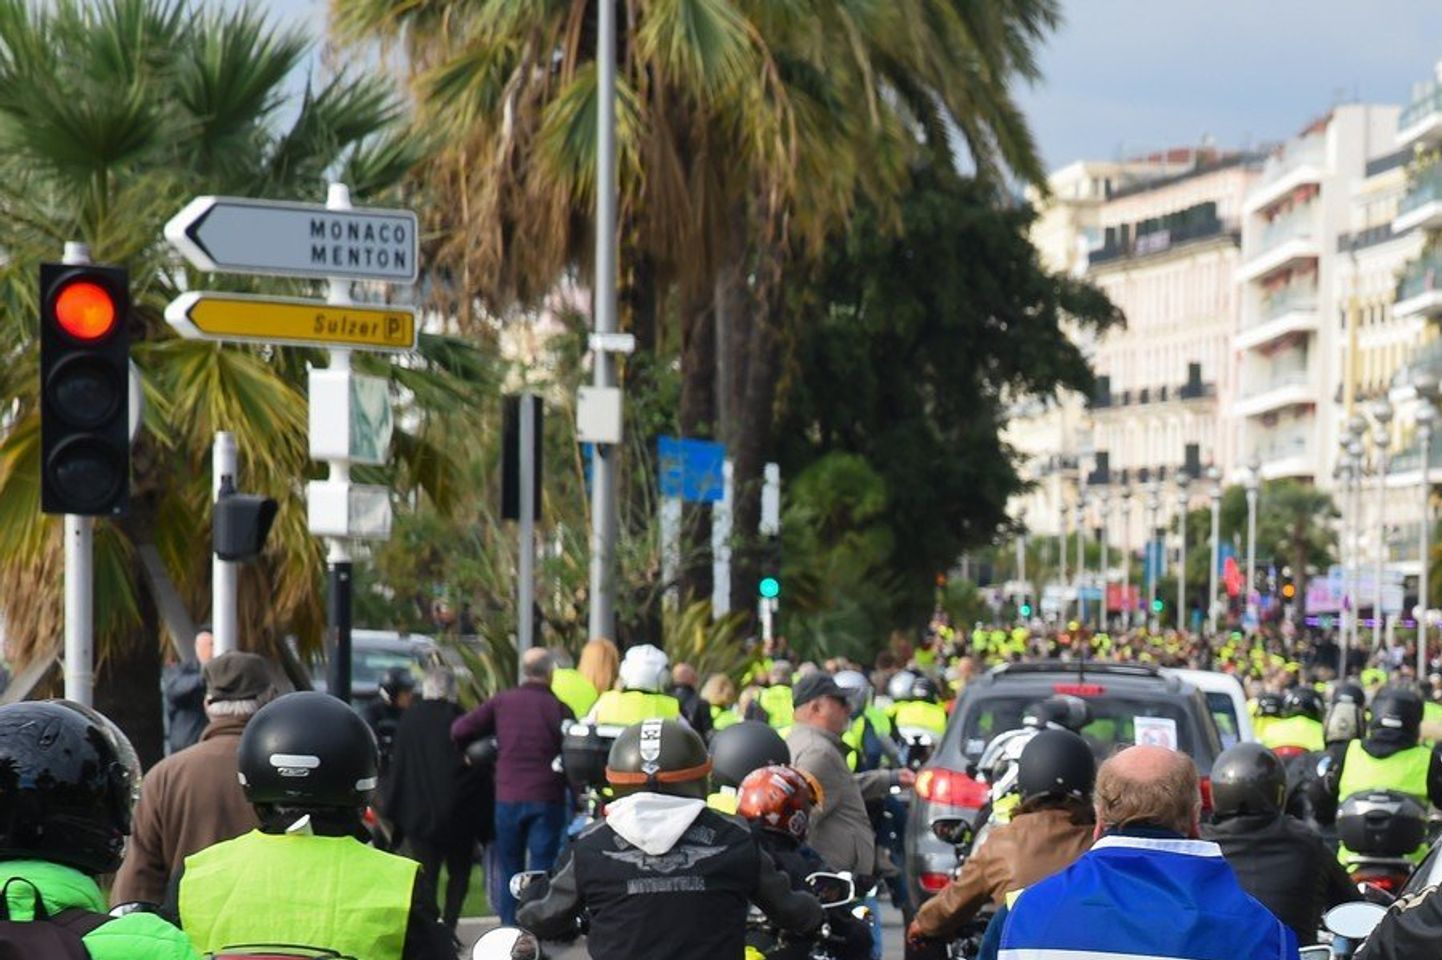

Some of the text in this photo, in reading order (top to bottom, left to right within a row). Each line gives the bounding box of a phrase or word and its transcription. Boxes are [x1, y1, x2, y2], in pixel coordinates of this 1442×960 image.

[310, 218, 405, 244] MONACO
[311, 244, 406, 268] MENTON
[314, 313, 379, 337] Sulzer
